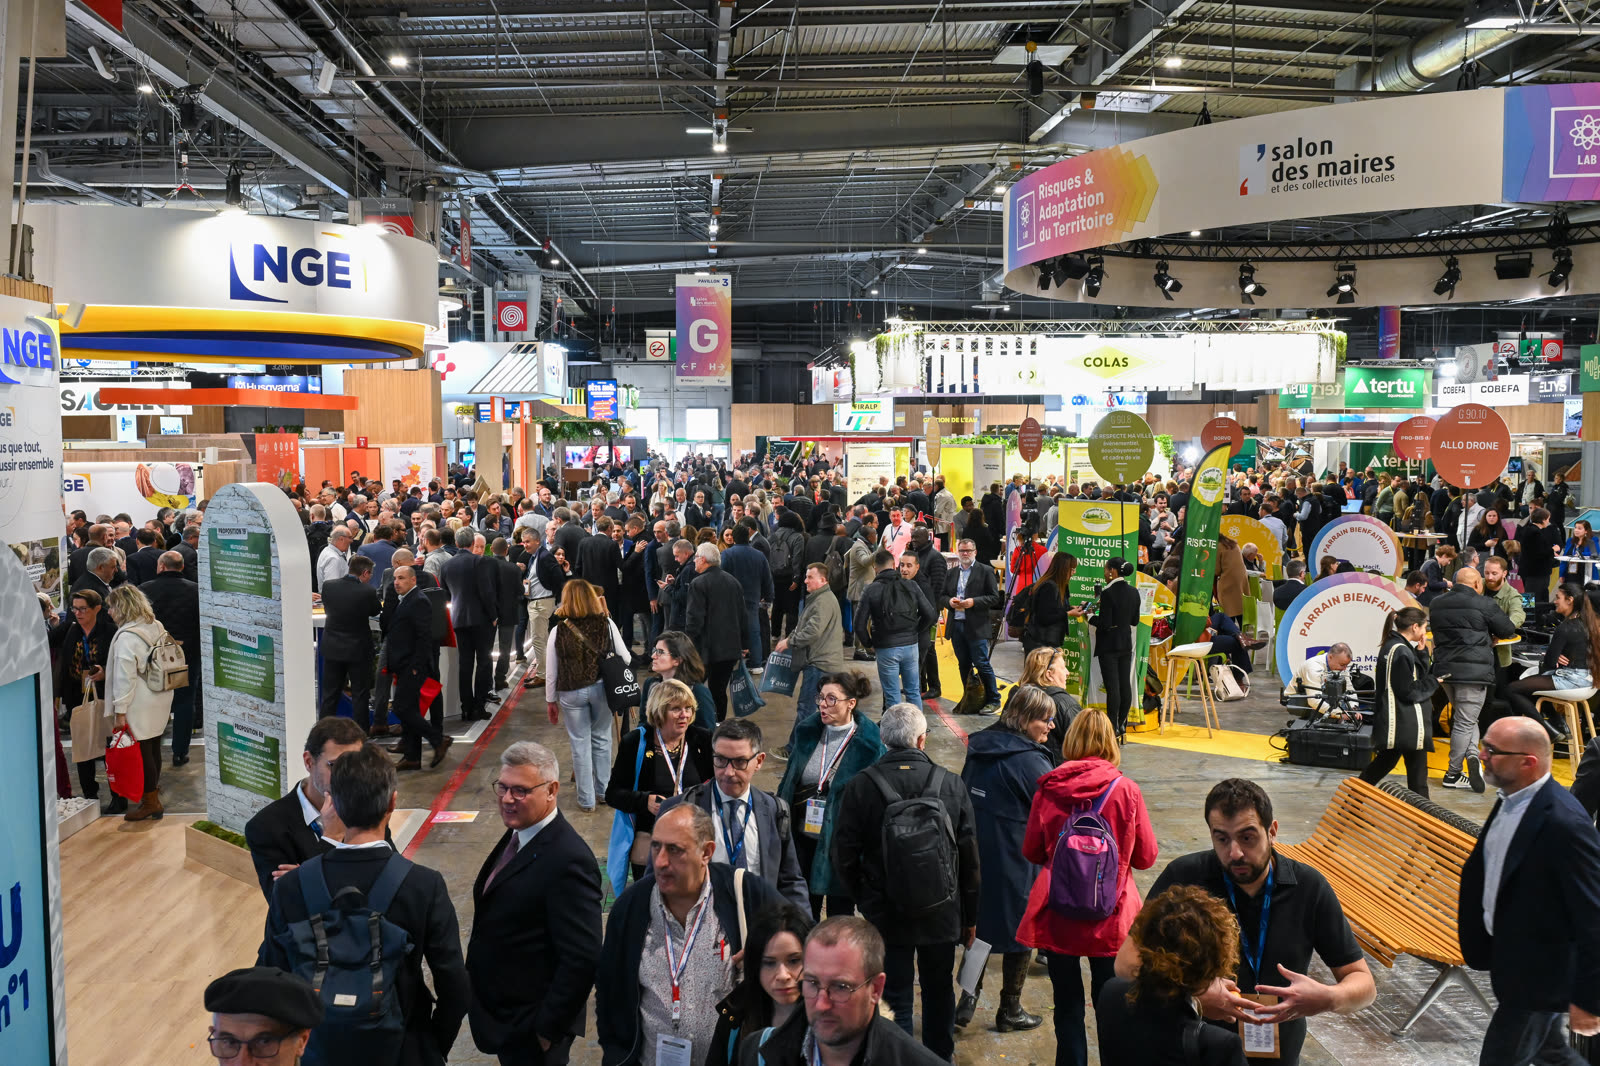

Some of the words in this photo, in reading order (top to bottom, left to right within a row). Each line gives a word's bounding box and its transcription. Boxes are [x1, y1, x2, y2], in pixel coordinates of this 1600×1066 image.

[1271, 137, 1333, 162] salon
[1577, 154, 1597, 166] LAB
[1271, 161, 1309, 183] des
[1317, 154, 1396, 179] maires
[1038, 175, 1081, 200] Risques
[1084, 168, 1094, 185] &
[1270, 185, 1280, 194] et
[1283, 182, 1299, 193] des
[1301, 175, 1358, 191] collectivités
[1361, 173, 1395, 185] locales
[1038, 191, 1105, 222] Adaptation
[1039, 226, 1051, 242] du
[1053, 211, 1114, 240] Territoire
[253, 243, 352, 289] NGE
[722, 278, 729, 287] 3
[689, 318, 719, 354] G
[3, 328, 53, 369] NGE
[691, 363, 697, 371] F
[709, 363, 716, 371] H
[1083, 357, 1129, 368] COLAS
[1369, 377, 1417, 394] tertu
[1442, 386, 1466, 394] COBEFA
[1480, 384, 1520, 394] COBEFA
[0, 413, 12, 427] GE
[1458, 409, 1465, 419] G
[1466, 409, 1487, 419] 90.10
[10, 443, 23, 456] que
[24, 441, 42, 454] tout,
[1440, 441, 1464, 450] ALLO
[1466, 441, 1499, 450] DRONE
[19, 457, 54, 470] ensemble
[1066, 535, 1130, 549] S'IMPLIQUER
[1322, 528, 1349, 554] PARRAIN
[1350, 526, 1390, 555] BIENFAITEUR
[1084, 547, 1111, 558] TOUS
[1076, 558, 1107, 568] NSEM
[1299, 595, 1341, 637] PARRAIN
[228, 629, 252, 642] PROPOSITION
[234, 722, 258, 736] PROPOSITION
